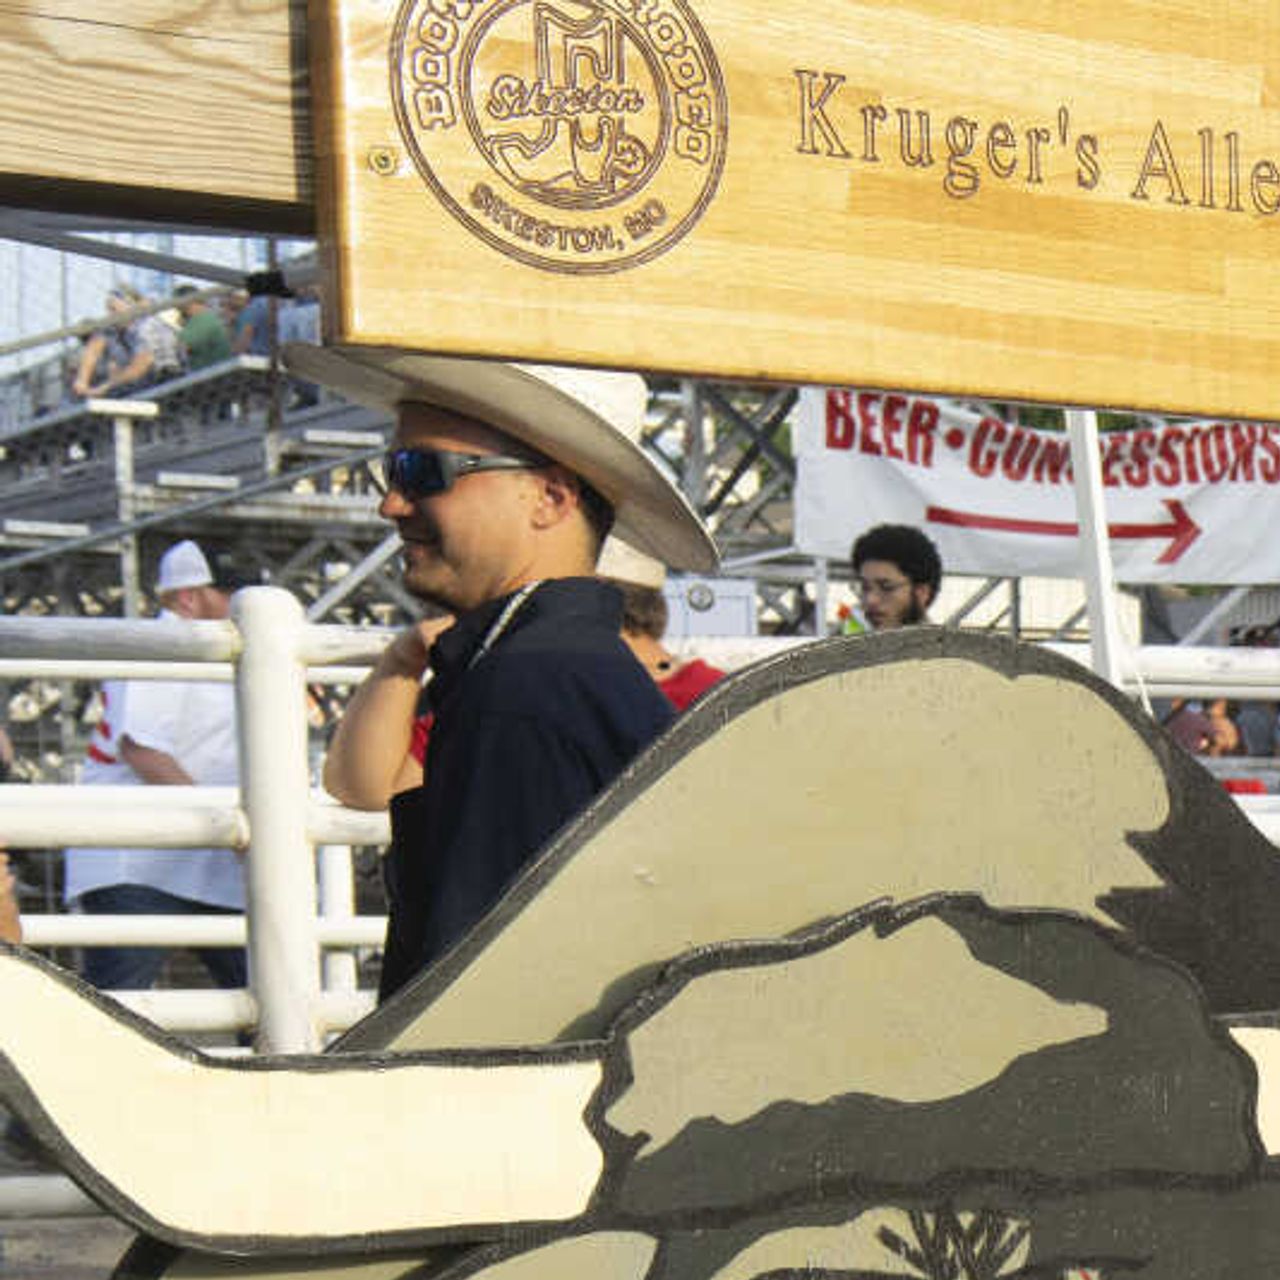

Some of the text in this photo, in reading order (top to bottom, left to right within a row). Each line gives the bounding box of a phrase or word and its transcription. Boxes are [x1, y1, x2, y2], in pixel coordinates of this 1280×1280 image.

[795, 68, 1101, 199] Kruger's
[624, 199, 667, 241] MO
[825, 388, 940, 469] BEER
